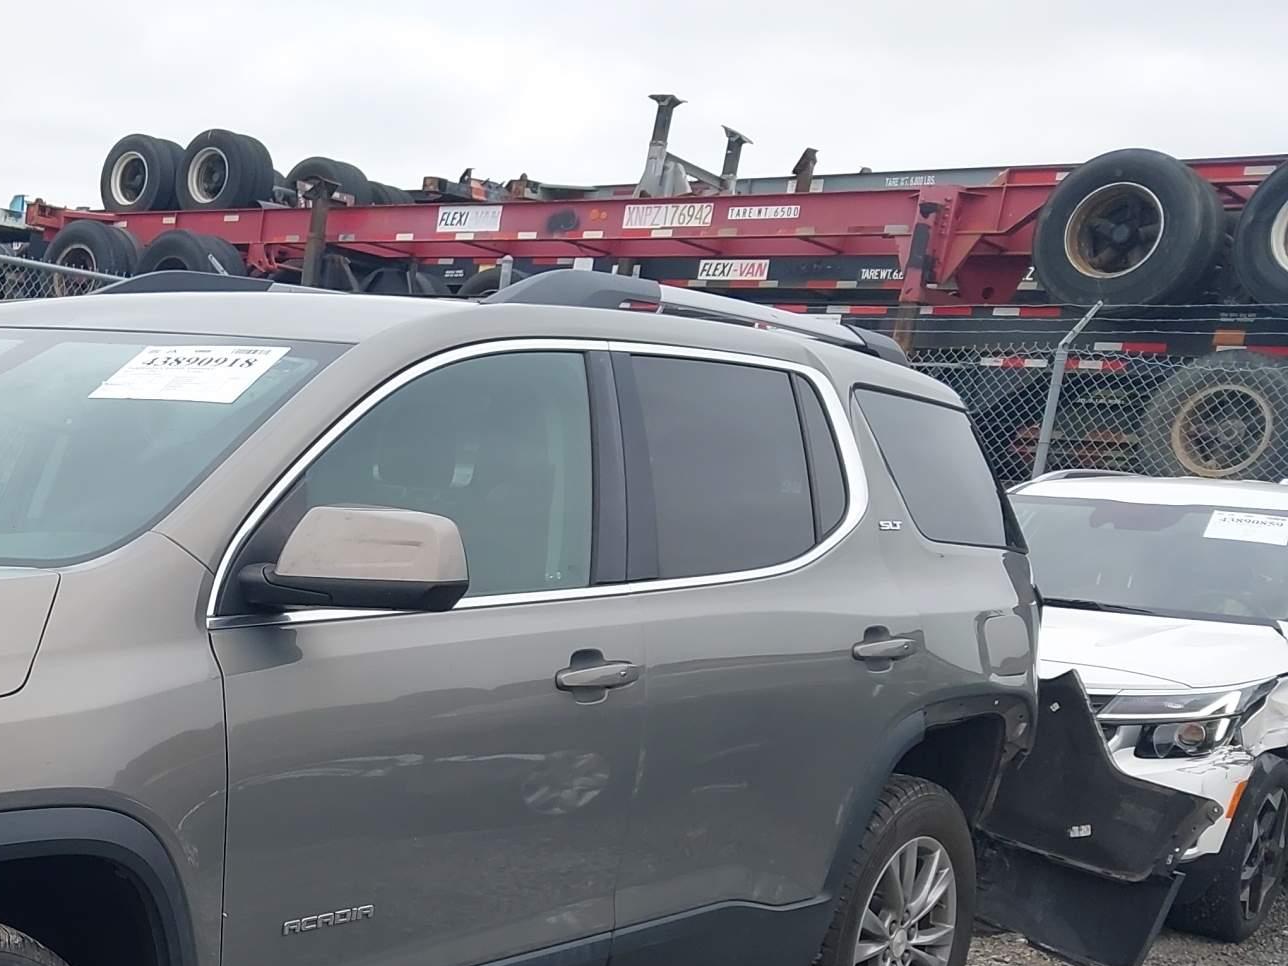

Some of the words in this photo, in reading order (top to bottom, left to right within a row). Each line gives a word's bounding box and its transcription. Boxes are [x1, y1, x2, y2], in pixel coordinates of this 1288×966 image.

[439, 211, 470, 227] FLEXI
[729, 207, 754, 219] TARE
[774, 206, 799, 218] 6500
[699, 261, 767, 278] FLEXI-VAN
[861, 268, 879, 280] TARE
[141, 356, 258, 369] 43890918
[878, 520, 903, 531] SLT
[282, 904, 375, 936] ACADIA
